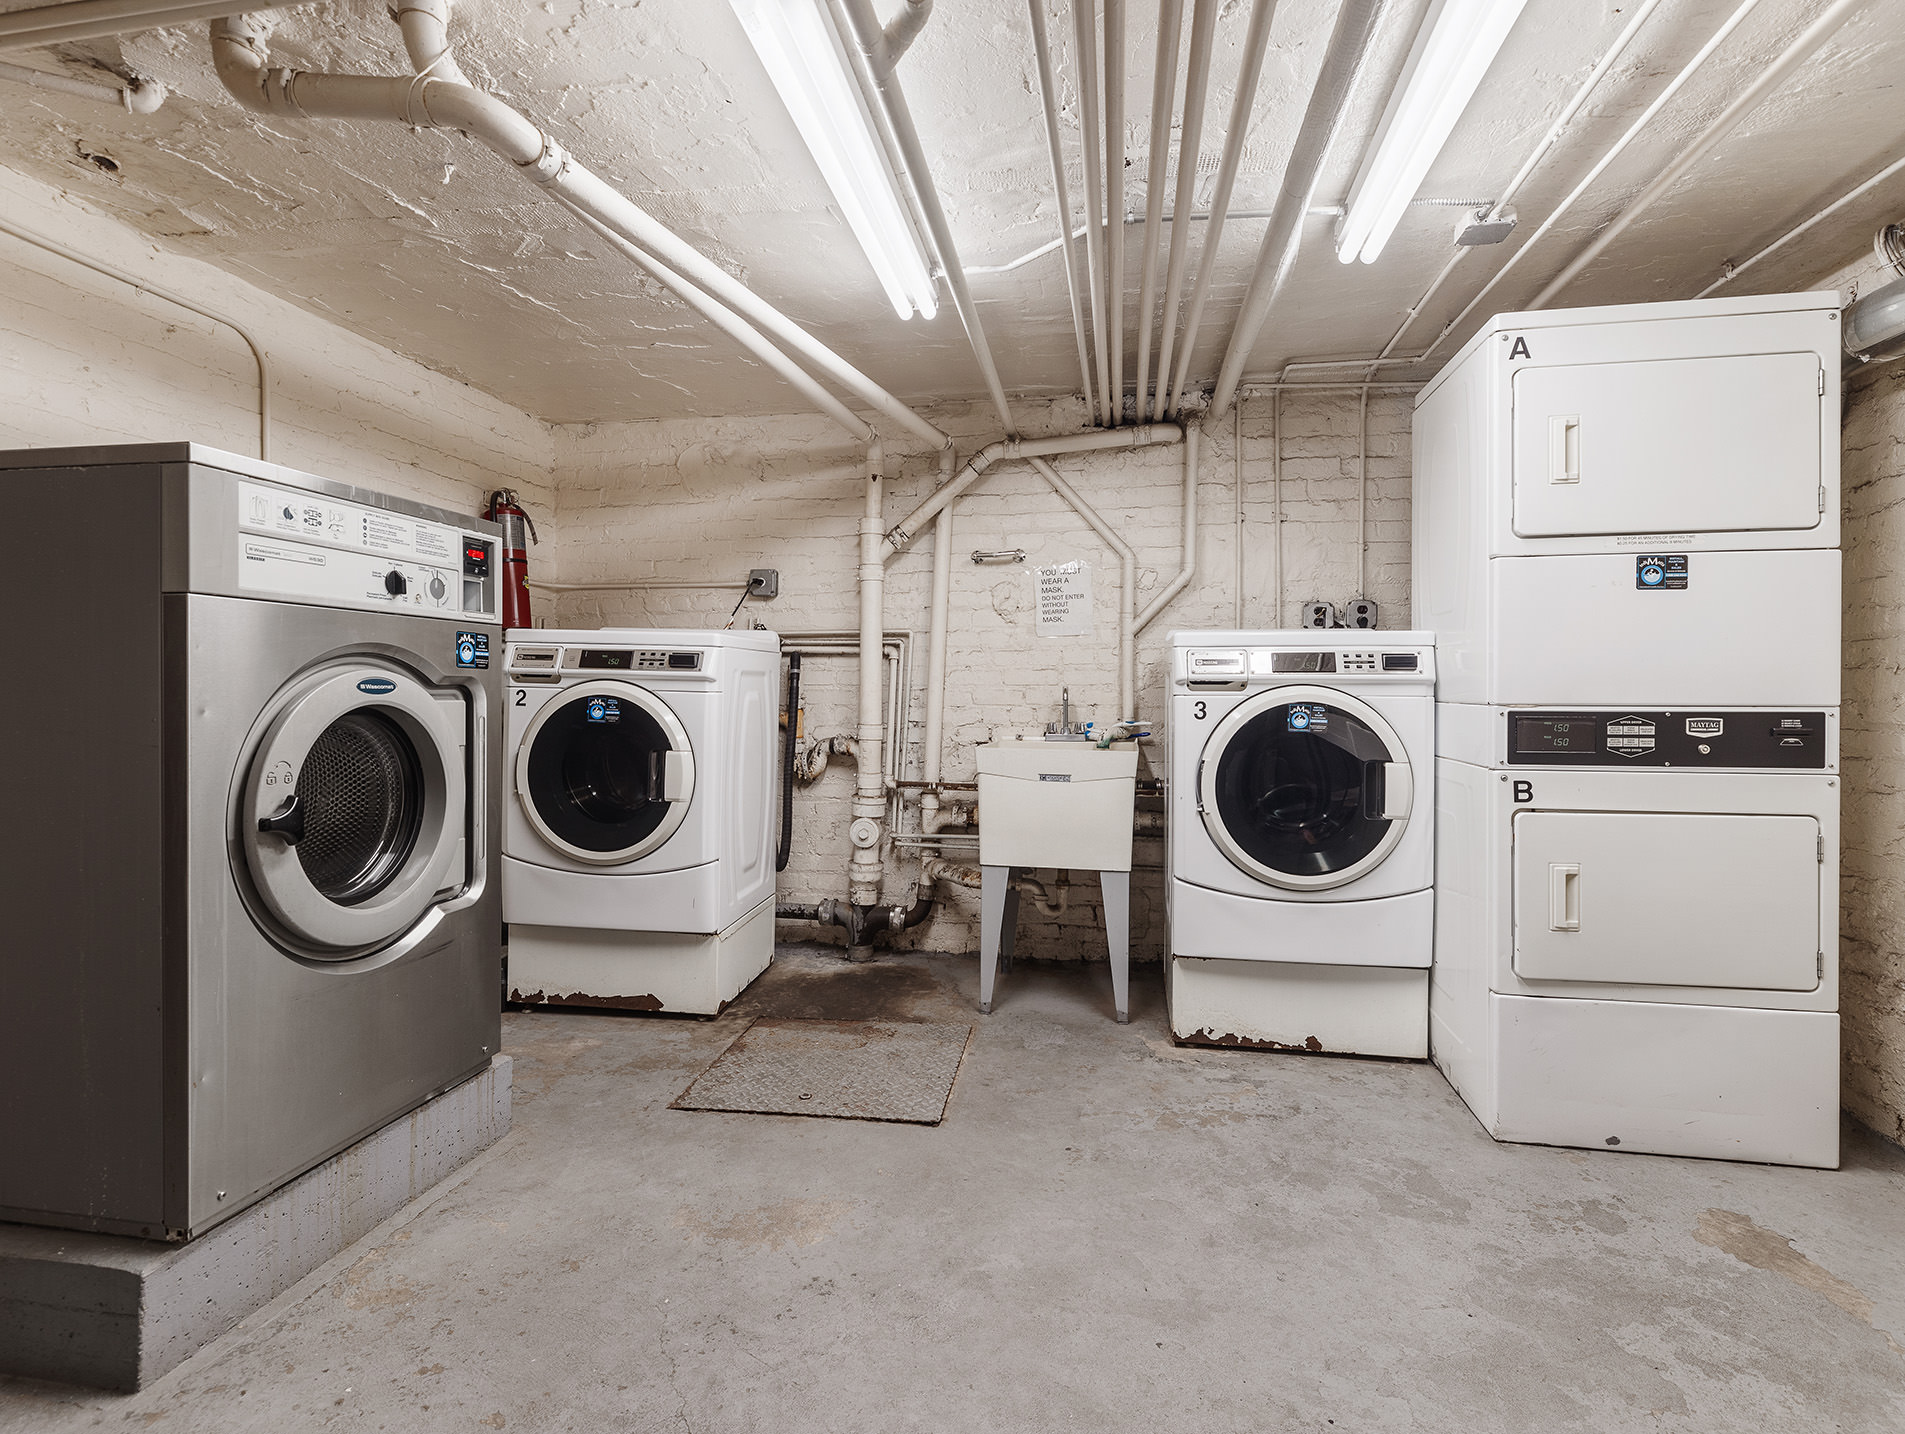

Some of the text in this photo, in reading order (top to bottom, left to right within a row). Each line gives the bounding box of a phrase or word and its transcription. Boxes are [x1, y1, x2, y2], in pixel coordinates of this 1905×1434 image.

[1509, 336, 1532, 360] A
[1040, 577, 1063, 585] WEAR
[1041, 586, 1065, 594] MASK.
[515, 689, 527, 707] 2
[1193, 701, 1207, 720] 3
[1513, 780, 1534, 803] B
